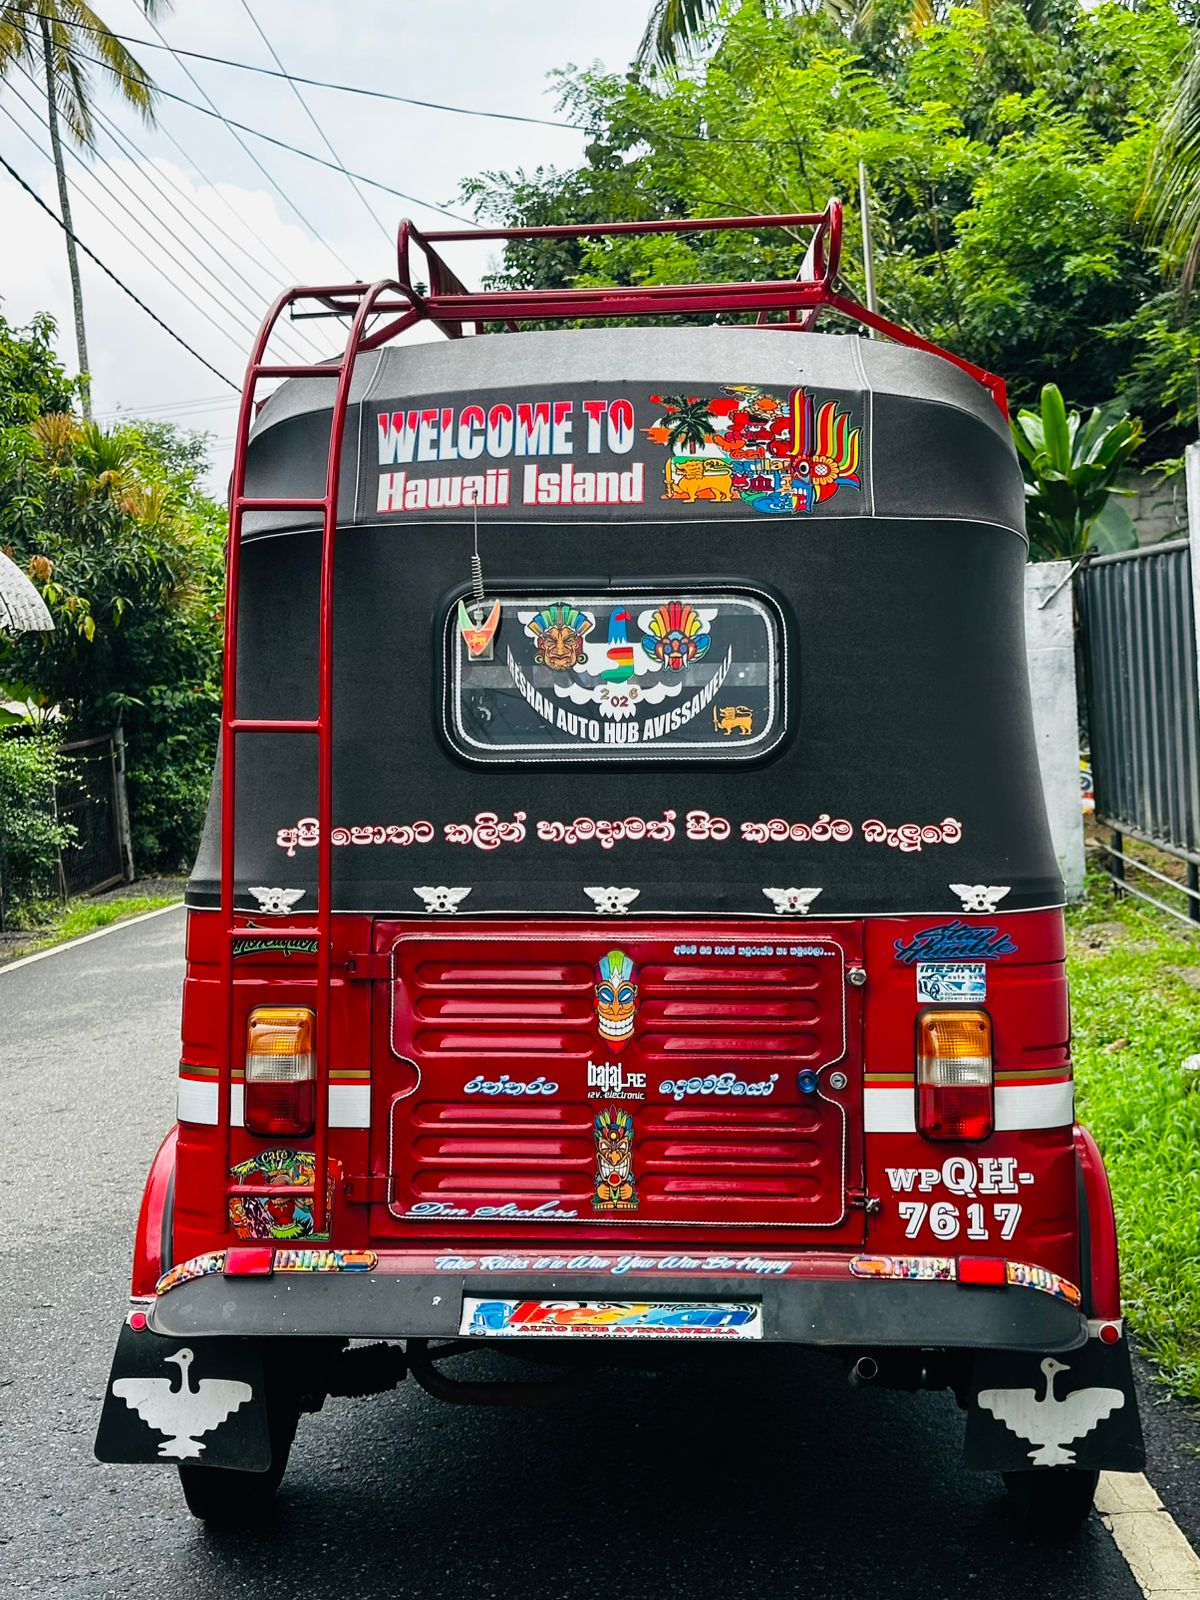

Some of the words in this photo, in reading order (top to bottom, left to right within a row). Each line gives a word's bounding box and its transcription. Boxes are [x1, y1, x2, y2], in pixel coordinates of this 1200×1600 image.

[377, 401, 573, 466] WELCOME
[582, 398, 635, 455] TO
[376, 467, 511, 514] Hawaii
[523, 462, 645, 507] Island
[556, 707, 600, 743] AUTO
[604, 721, 639, 743] HUB
[588, 1060, 622, 1092] bajaj
[626, 1072, 647, 1088] RE
[898, 1201, 1023, 1240] 7617
[434, 1255, 477, 1270] Take
[479, 1255, 530, 1271] Risks
[735, 1257, 793, 1274] Happy
